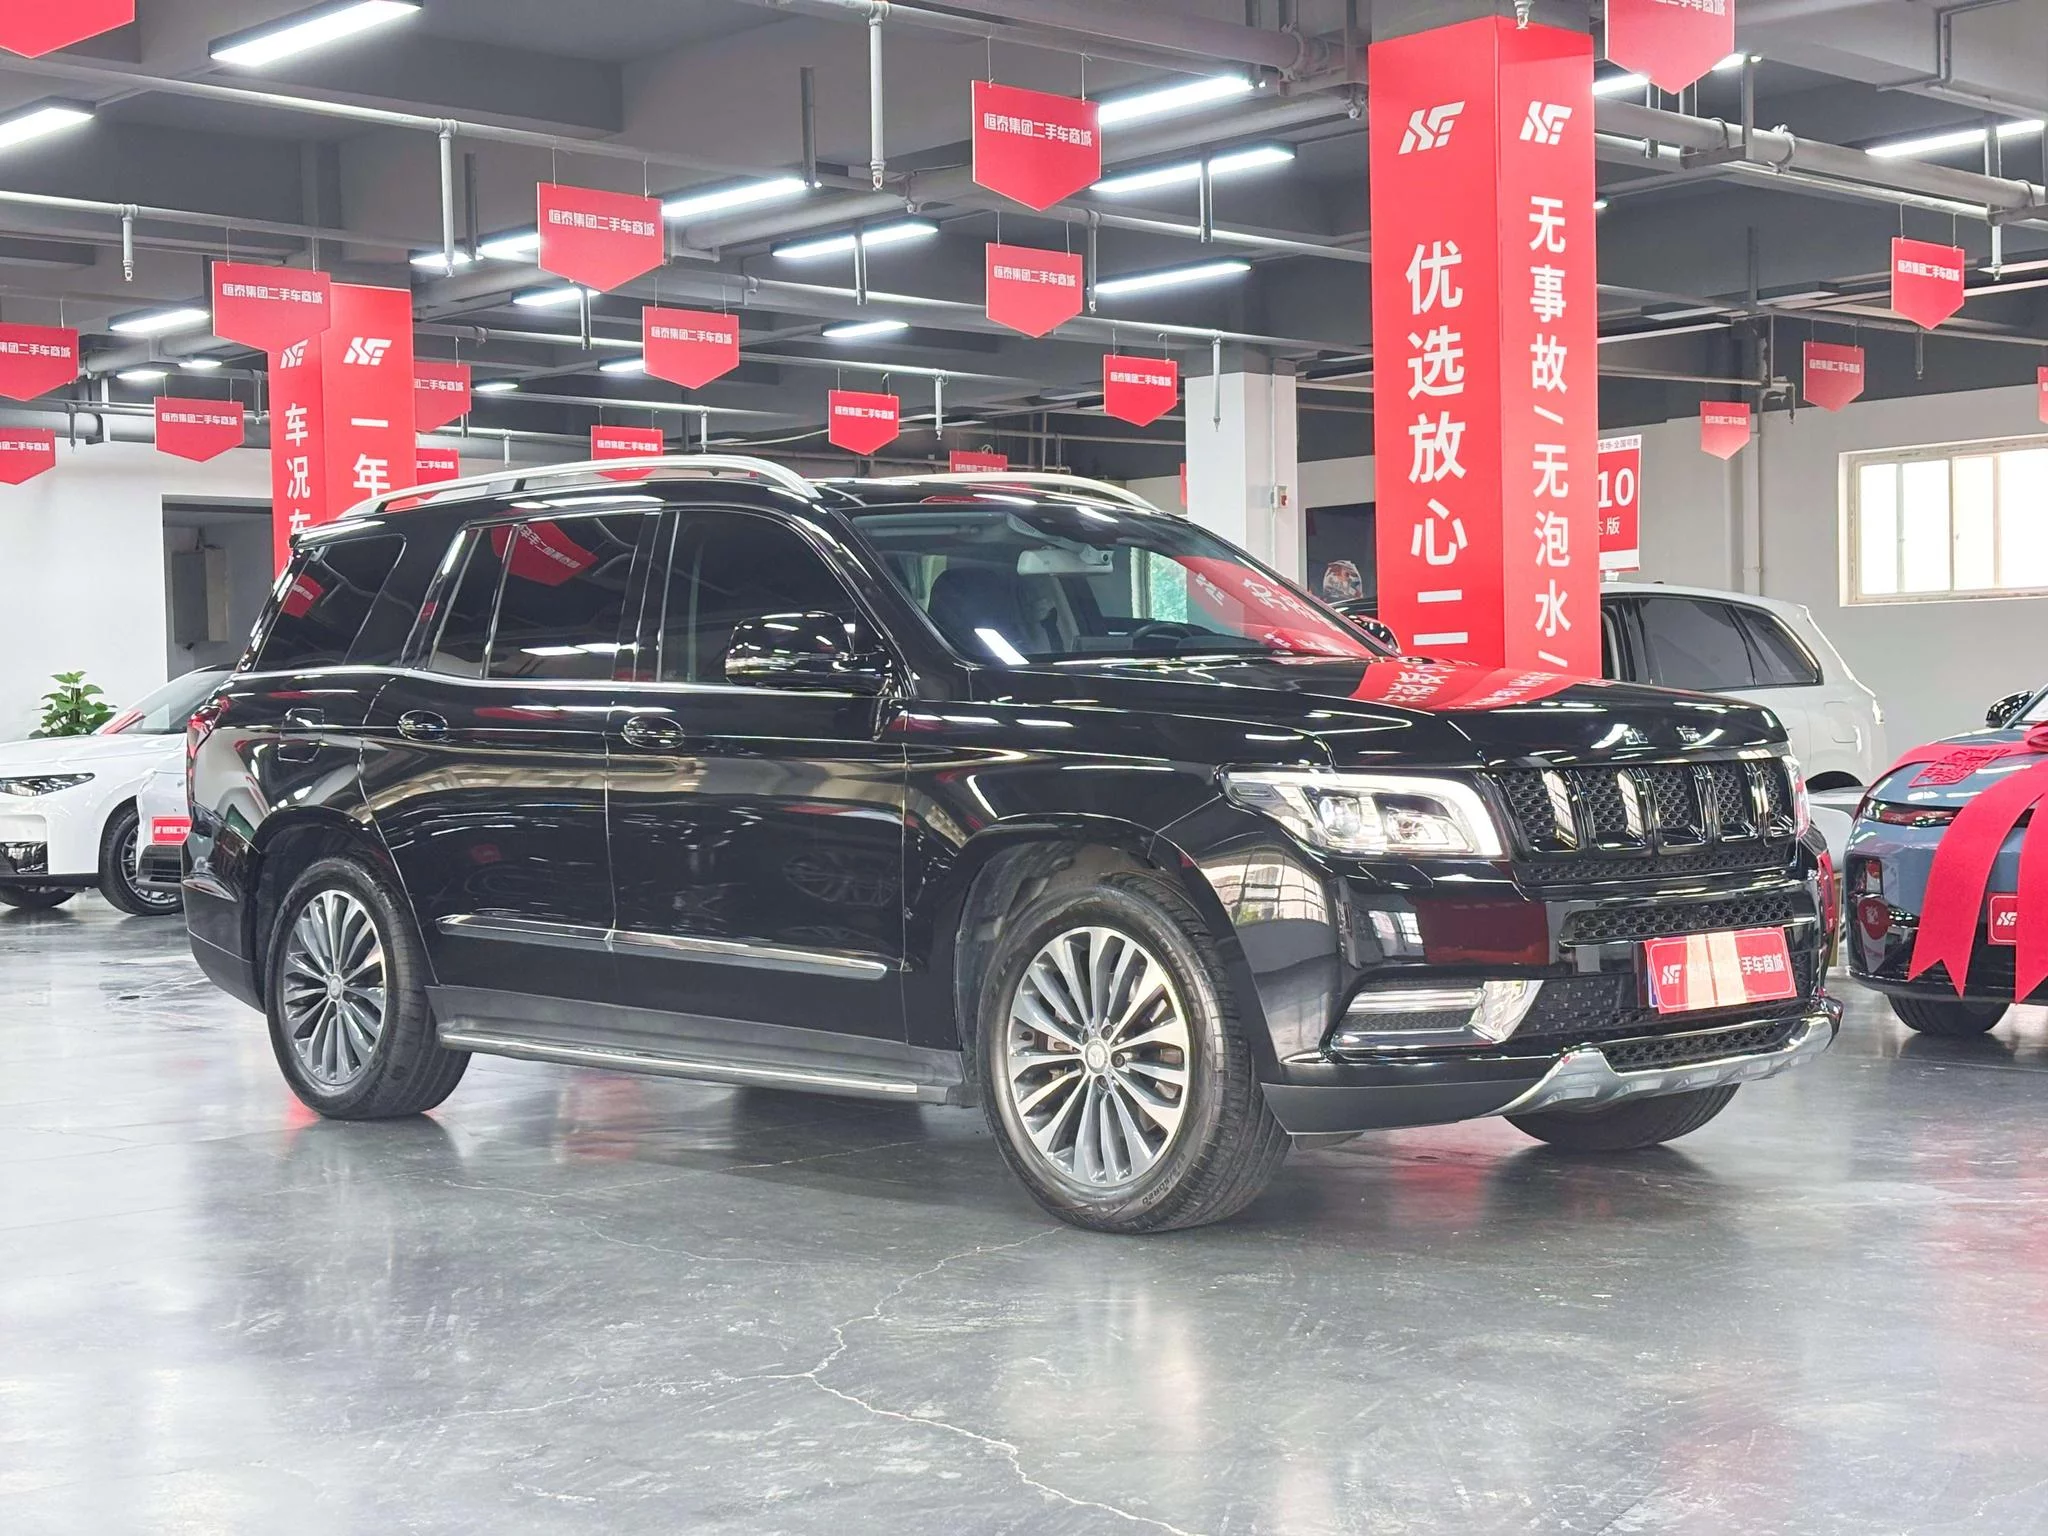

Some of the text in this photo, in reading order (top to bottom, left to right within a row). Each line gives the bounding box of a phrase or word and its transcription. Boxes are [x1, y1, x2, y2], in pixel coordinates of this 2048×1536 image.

[983, 112, 1093, 148] 恒泰集团二手车商城
[548, 209, 656, 237] 恒泰集团二手车商城
[993, 265, 1076, 288] 恒泰集团二手车商城
[222, 284, 323, 304] 恒泰集团二手车商城
[1738, 953, 1786, 976] 手车商城
